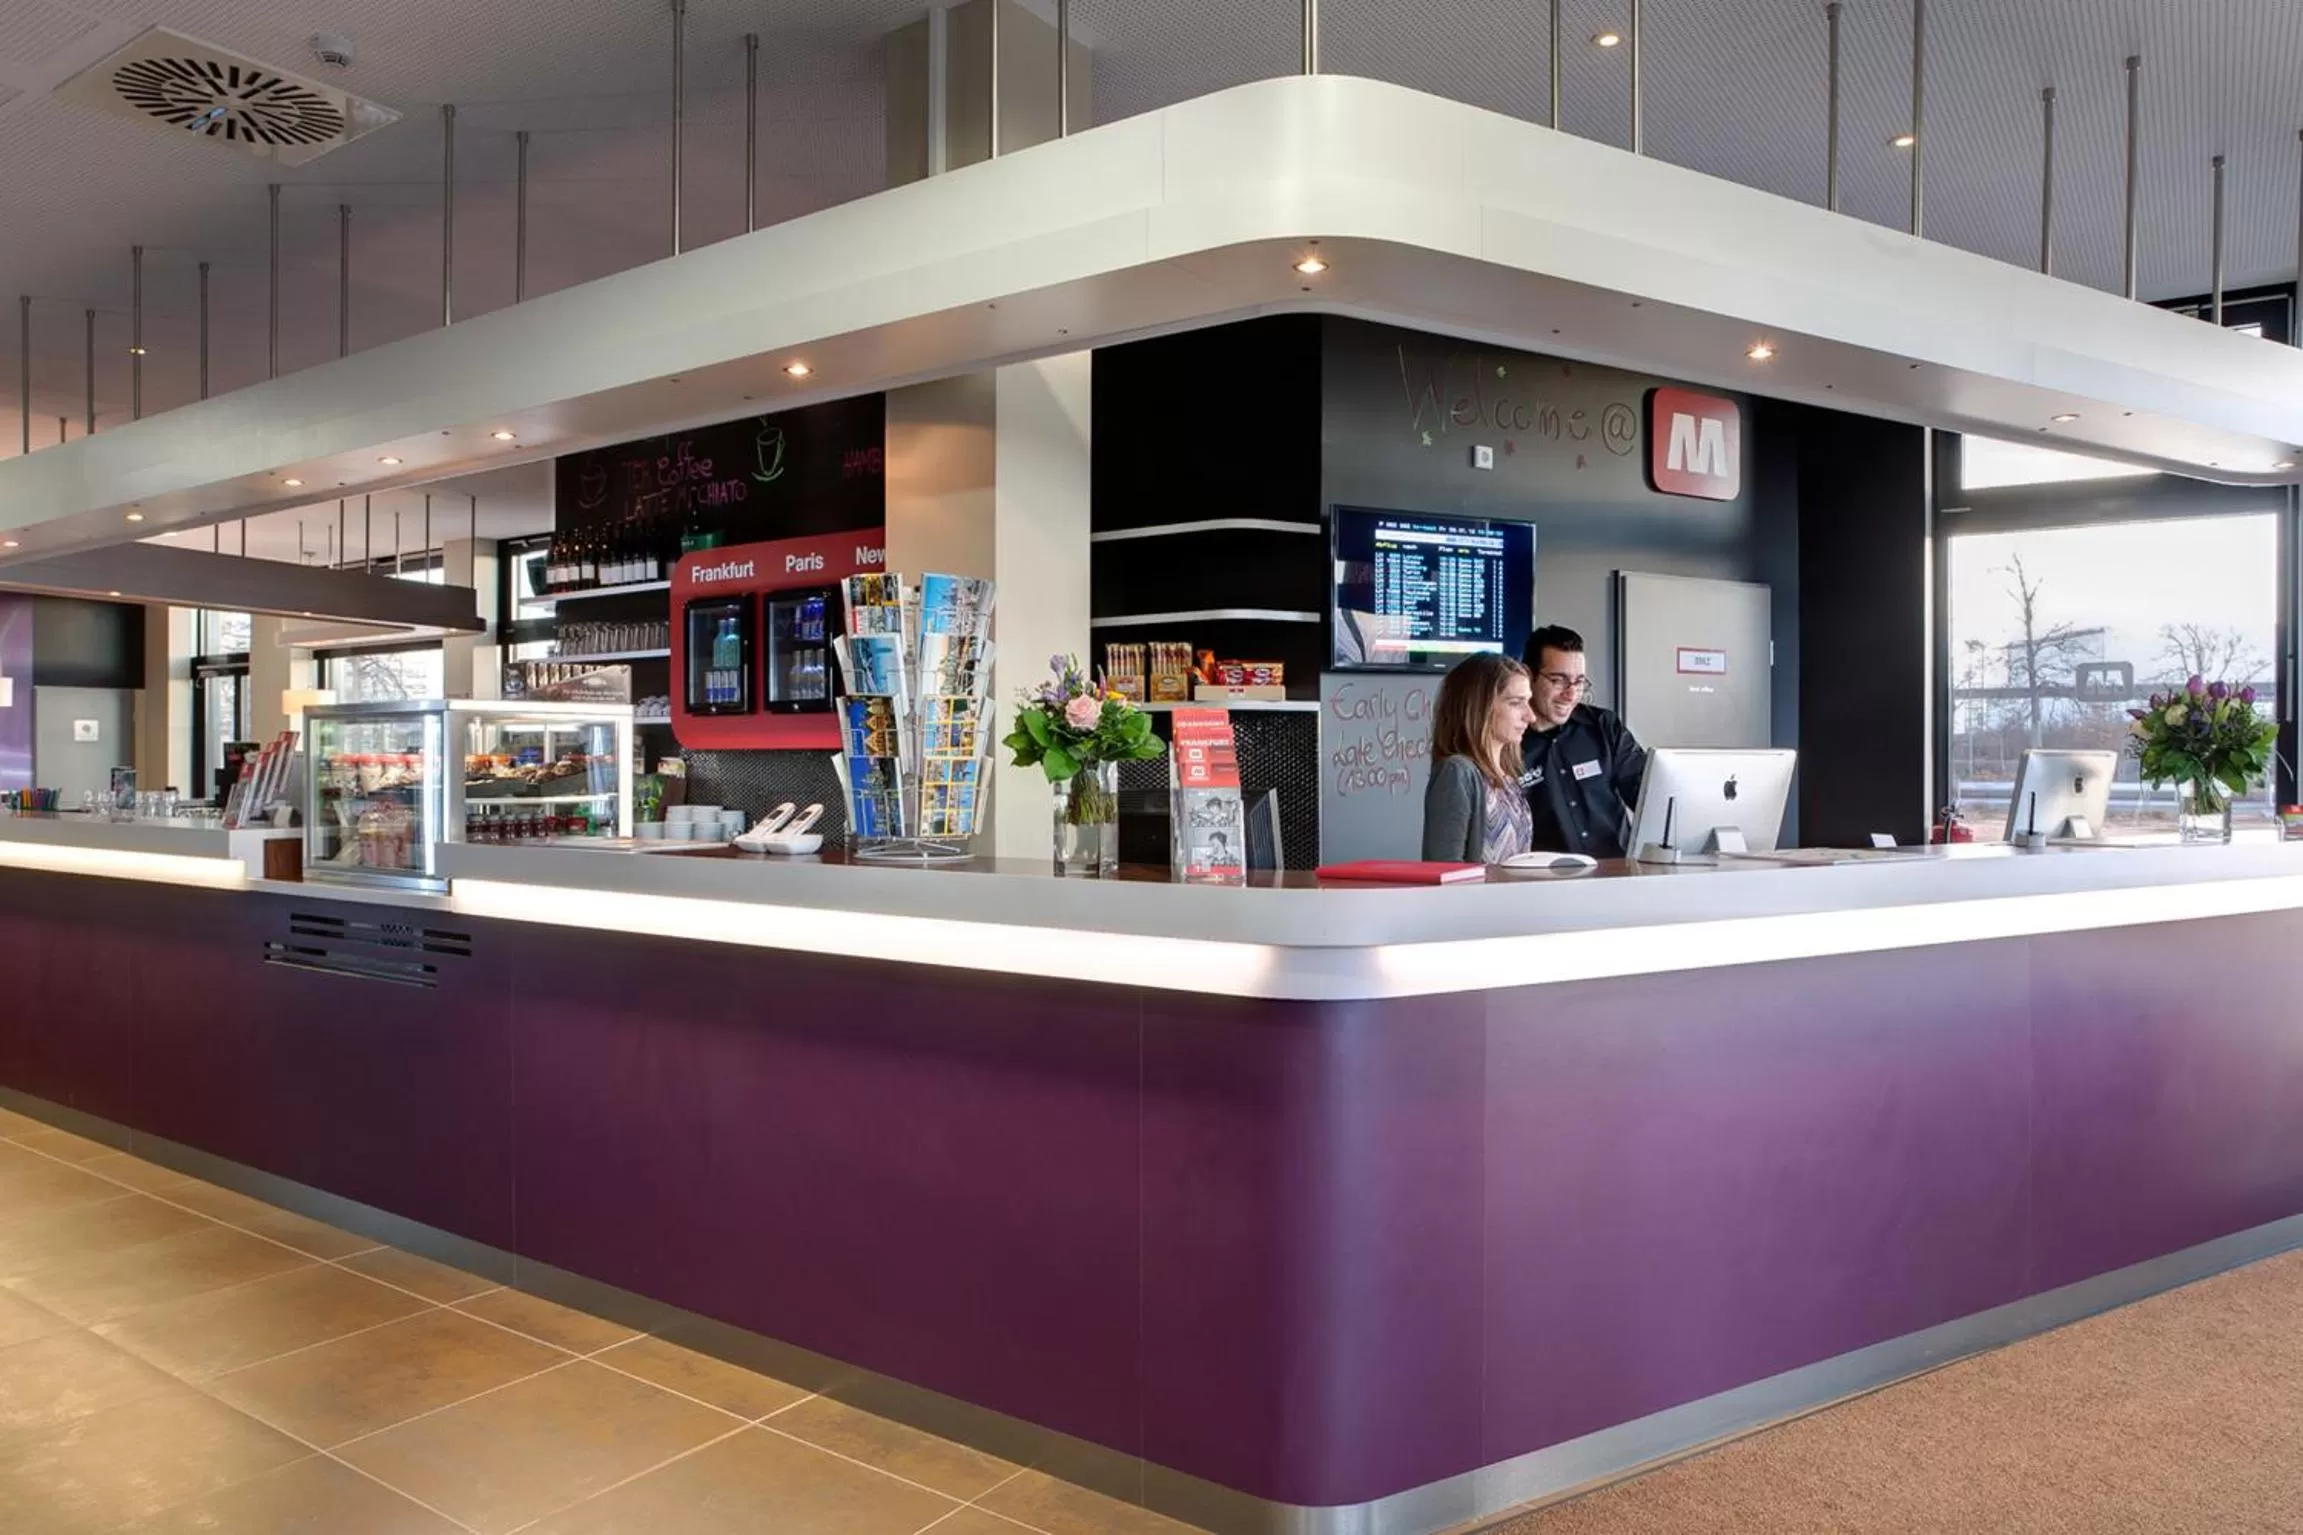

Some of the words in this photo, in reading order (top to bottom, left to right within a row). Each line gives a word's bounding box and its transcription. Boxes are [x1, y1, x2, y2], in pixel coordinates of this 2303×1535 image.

[1396, 343, 1592, 442] Welcome
[1600, 401, 1637, 458] @
[1666, 411, 1728, 478] M
[691, 559, 755, 583] Frankfurt
[785, 552, 824, 573] Paris
[1329, 682, 1399, 729] Early
